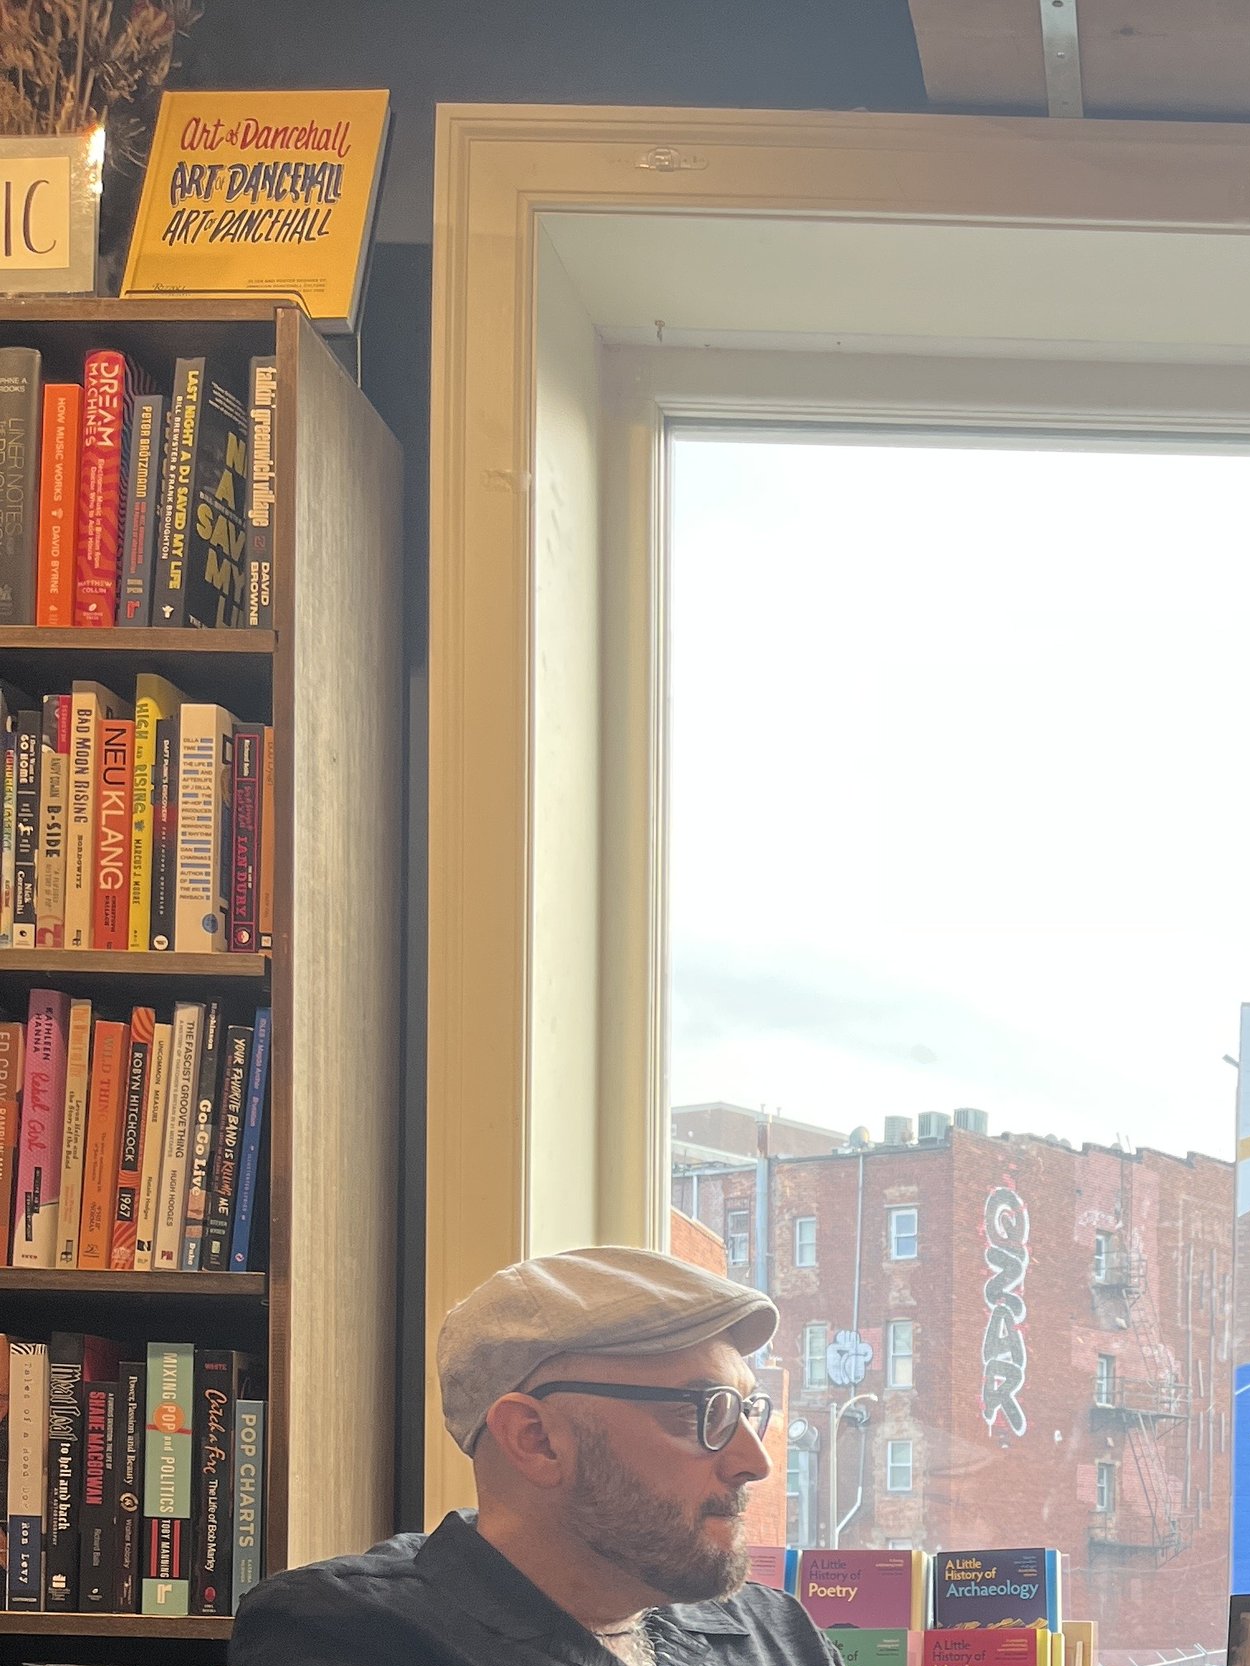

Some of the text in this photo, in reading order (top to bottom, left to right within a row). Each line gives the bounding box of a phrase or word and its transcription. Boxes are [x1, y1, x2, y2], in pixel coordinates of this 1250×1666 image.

[181, 117, 351, 159] Art of Dancehall
[170, 161, 346, 207] ART DANCEHALL
[162, 207, 333, 247] ART DANCEHALL
[85, 362, 98, 447] MACHINES
[97, 362, 119, 447] DREAM
[53, 397, 66, 505] HOW MUSIC WORKS
[250, 408, 276, 481] greenwich
[168, 370, 199, 590] LAST NIGHT A DJ SAVED MY LIFE
[248, 481, 276, 528] village
[249, 561, 260, 626] BROWNE
[260, 561, 270, 607] DAVID
[73, 708, 92, 824] BAD MOON RISING
[100, 727, 127, 891] NEU KLANG
[233, 1038, 246, 1065] YOUR
[124, 1051, 144, 1162] ROBYN HITCHCOCK
[228, 1067, 244, 1113] FAVORITE
[226, 1114, 240, 1148] BAND
[224, 1148, 234, 1160] IS
[119, 1193, 132, 1219] 1967
[218, 1199, 229, 1217] ME
[159, 1352, 177, 1514] MIXING POP and POLITICS
[238, 1414, 257, 1548] POP CHARTS
[809, 1569, 862, 1582] History of
[810, 1559, 847, 1570] A Little
[945, 1568, 996, 1583] History of
[946, 1558, 982, 1570] A Little
[808, 1582, 858, 1601] Poetry
[946, 1581, 1039, 1600] Archaeology
[932, 1650, 972, 1664] History
[974, 1650, 986, 1661] of
[933, 1640, 971, 1650] A Little
